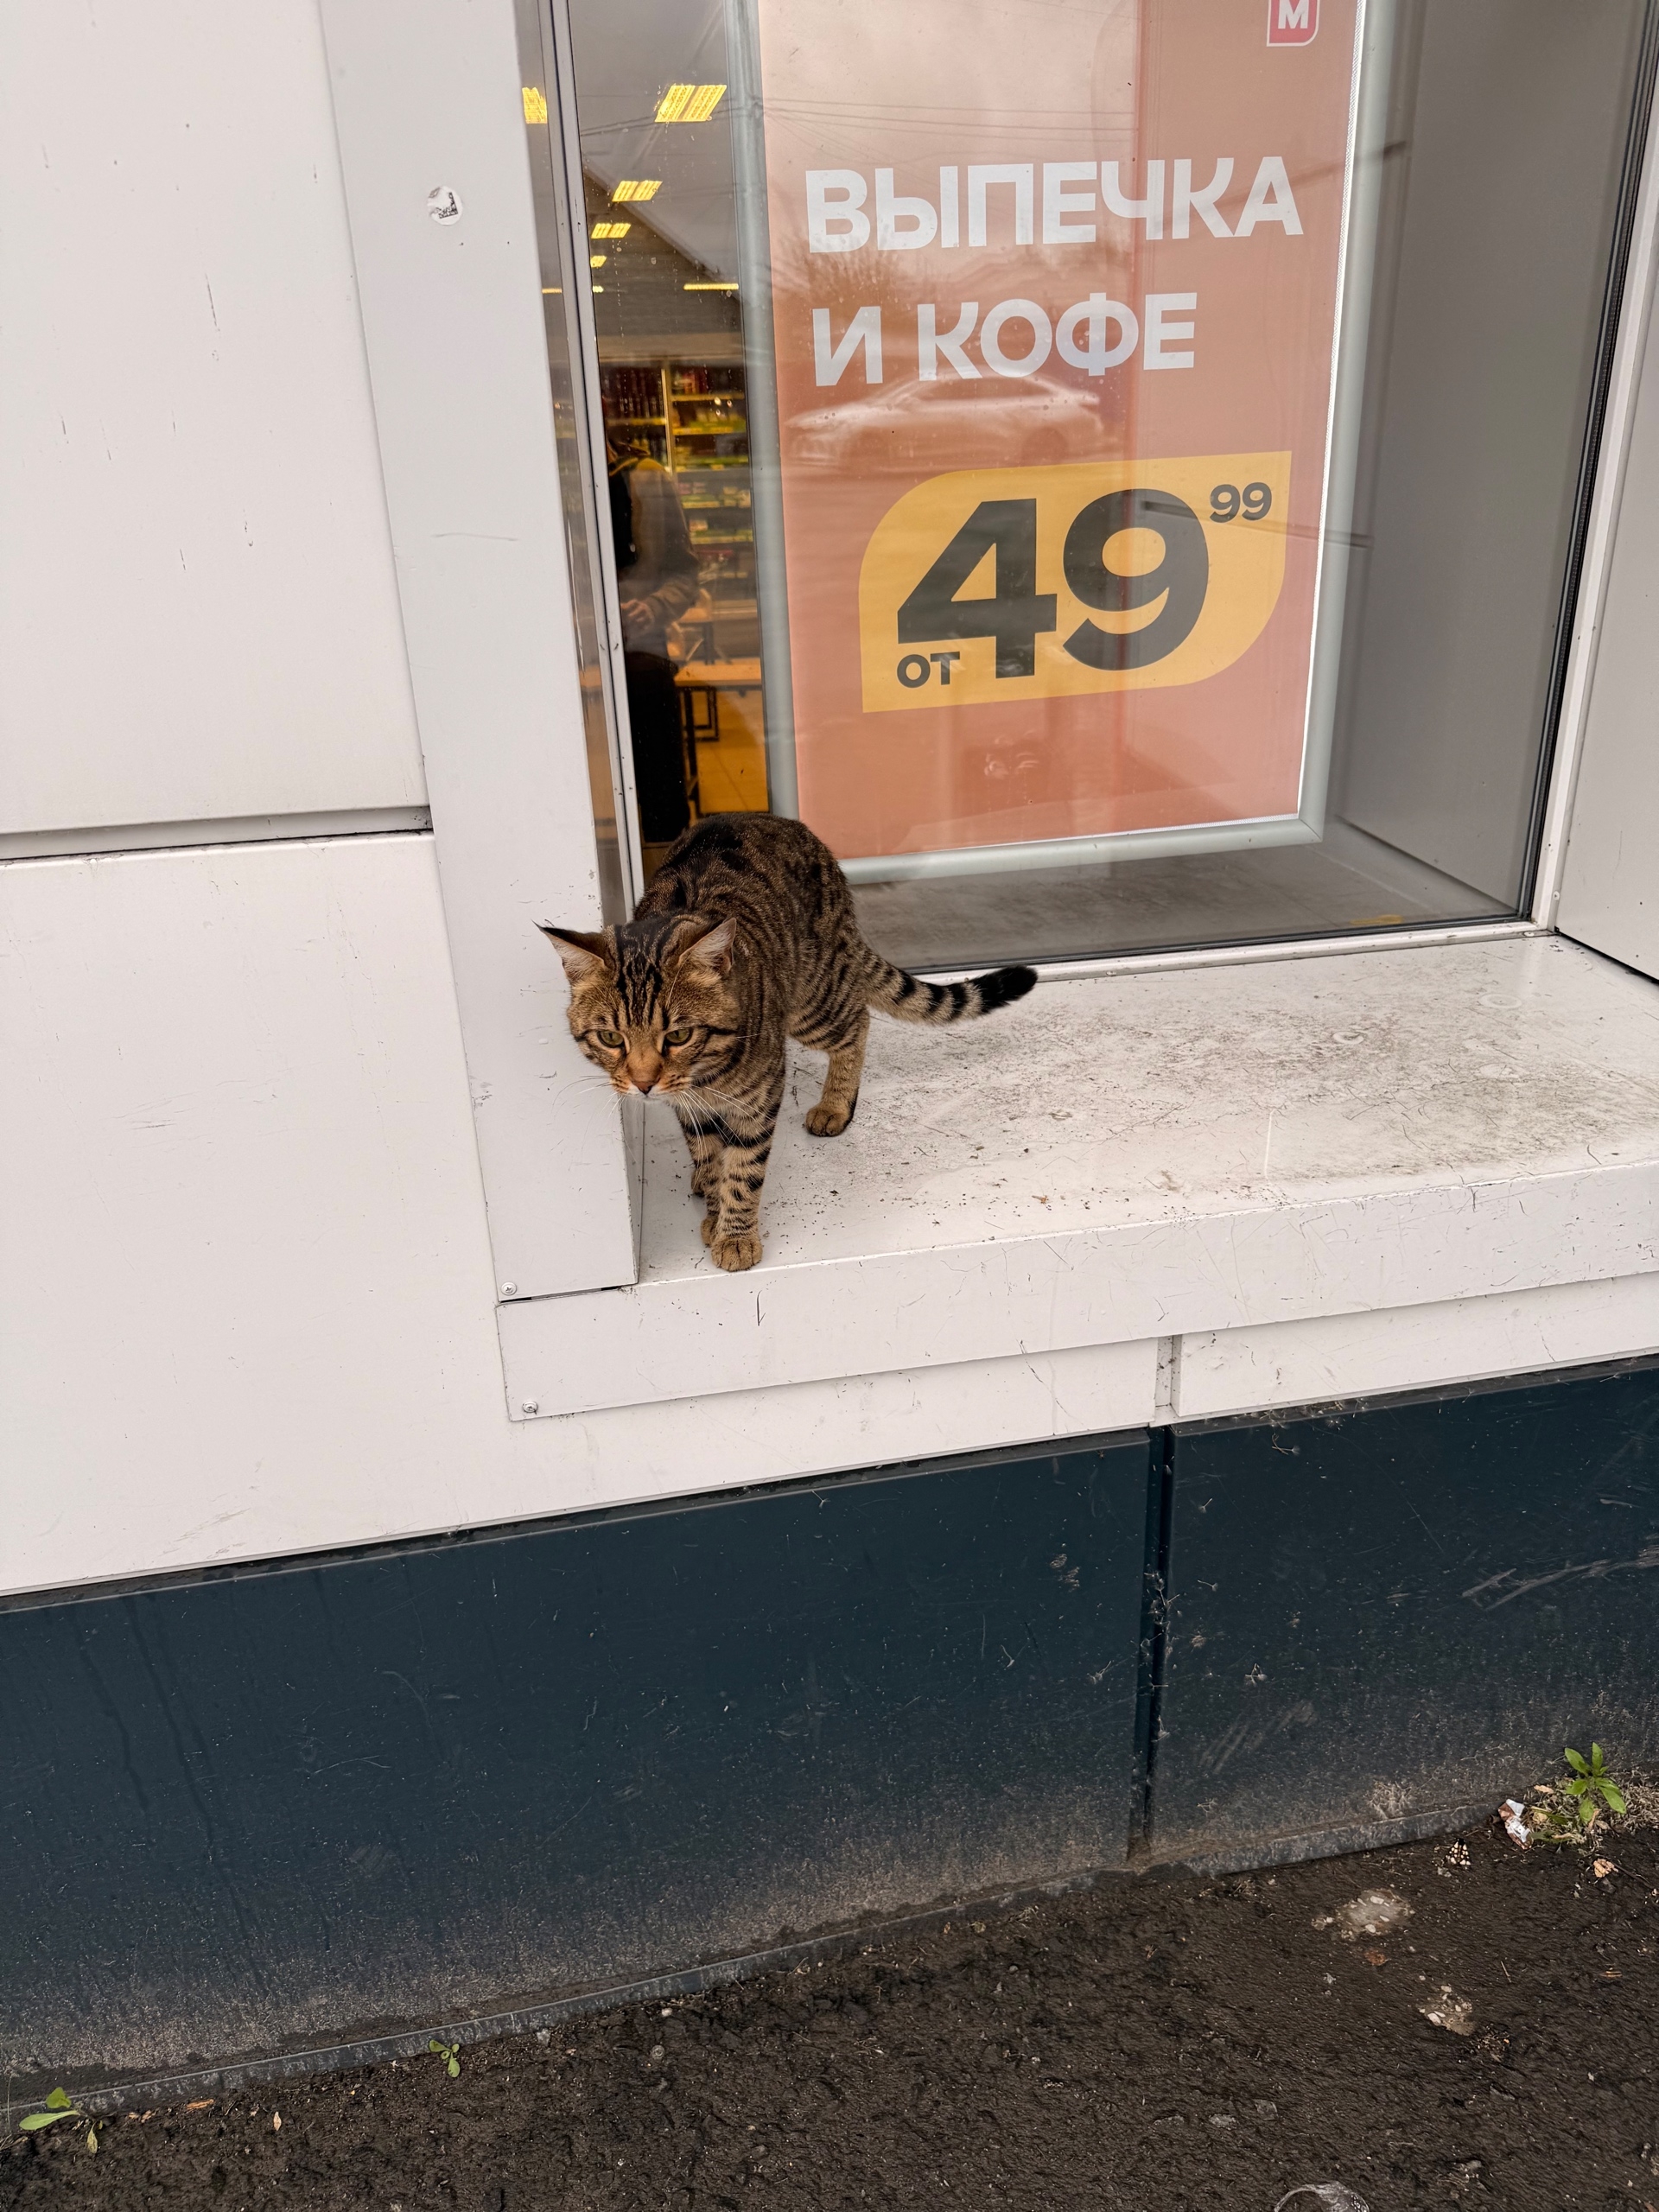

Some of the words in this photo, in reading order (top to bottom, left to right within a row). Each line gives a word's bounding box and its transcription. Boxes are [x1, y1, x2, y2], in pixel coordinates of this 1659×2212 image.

[805, 156, 1304, 253] ВЫПЕЧКА
[812, 306, 883, 386] И
[918, 292, 1198, 379] КОФЕ
[897, 488, 1209, 679] 49
[1210, 482, 1272, 523] 99
